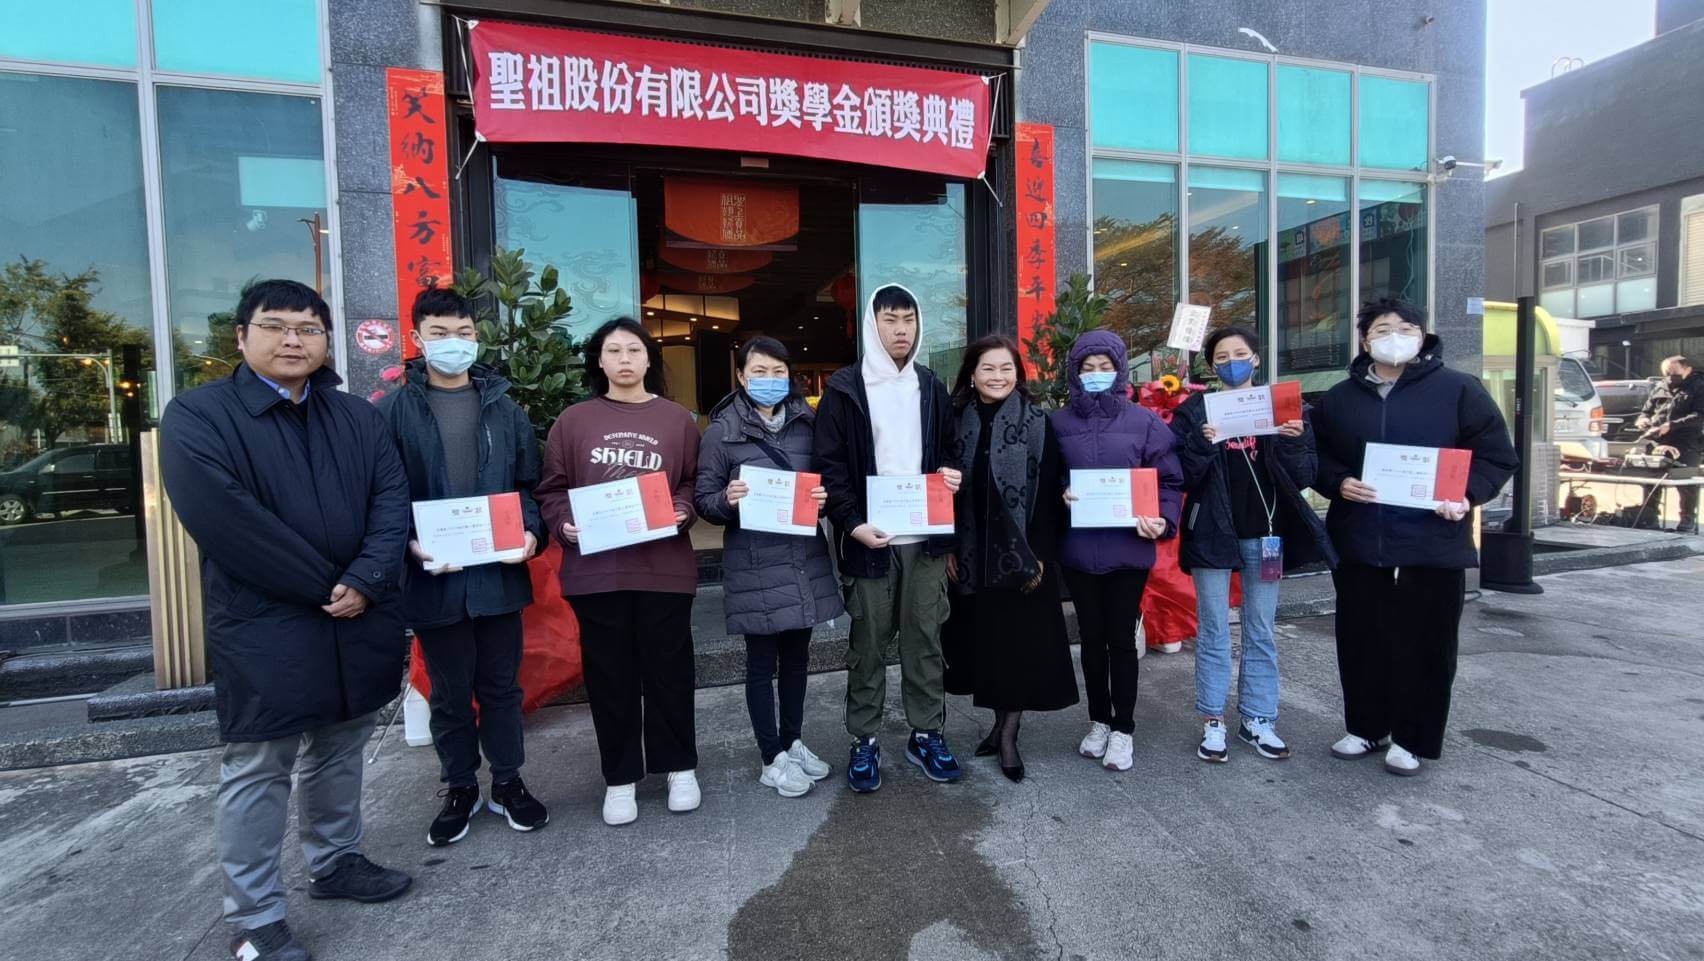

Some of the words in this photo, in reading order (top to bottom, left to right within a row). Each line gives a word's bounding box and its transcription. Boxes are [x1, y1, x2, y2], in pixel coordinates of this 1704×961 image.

[487, 51, 976, 151] 聖祖股份有限公司獎學金頒獎典禮
[590, 447, 662, 472] SHIELD
